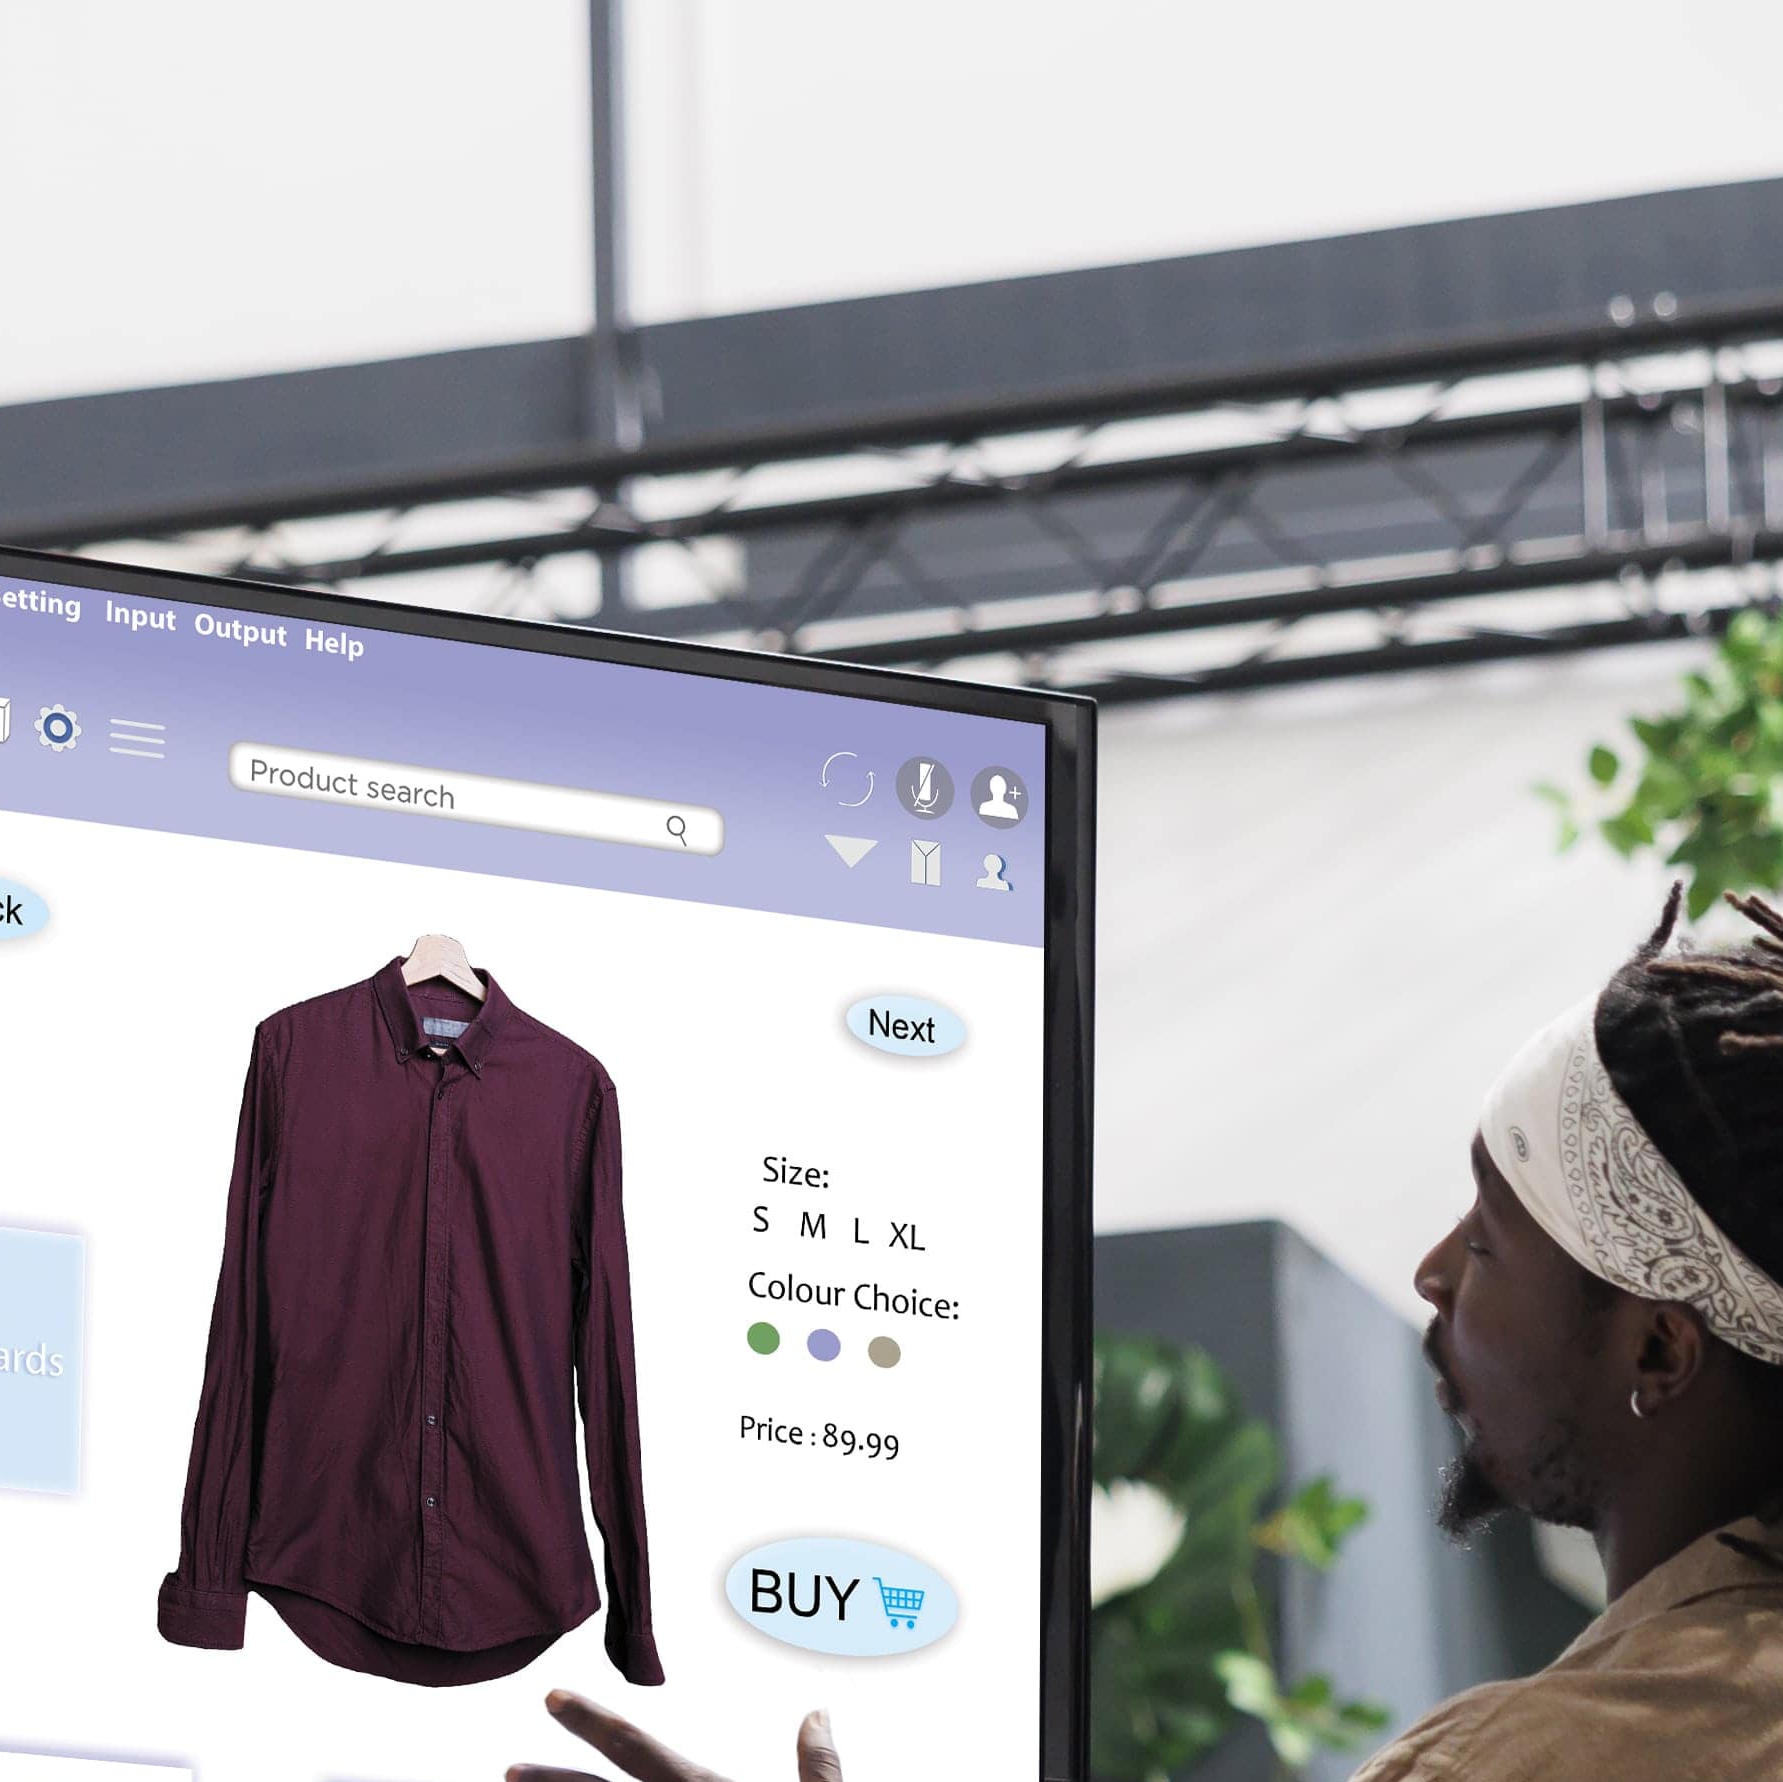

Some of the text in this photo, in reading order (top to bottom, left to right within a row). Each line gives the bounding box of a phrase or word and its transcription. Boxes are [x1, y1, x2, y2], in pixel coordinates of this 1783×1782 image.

[106, 599, 177, 632] Input
[194, 613, 287, 647] Output
[305, 628, 364, 662] Help
[251, 759, 454, 809] Product search
[869, 1007, 936, 1044] Next
[762, 1155, 829, 1189] Size:
[752, 1205, 926, 1252] S M L XL
[748, 1271, 960, 1321] Colour Choice:
[751, 1567, 861, 1622] BUY
